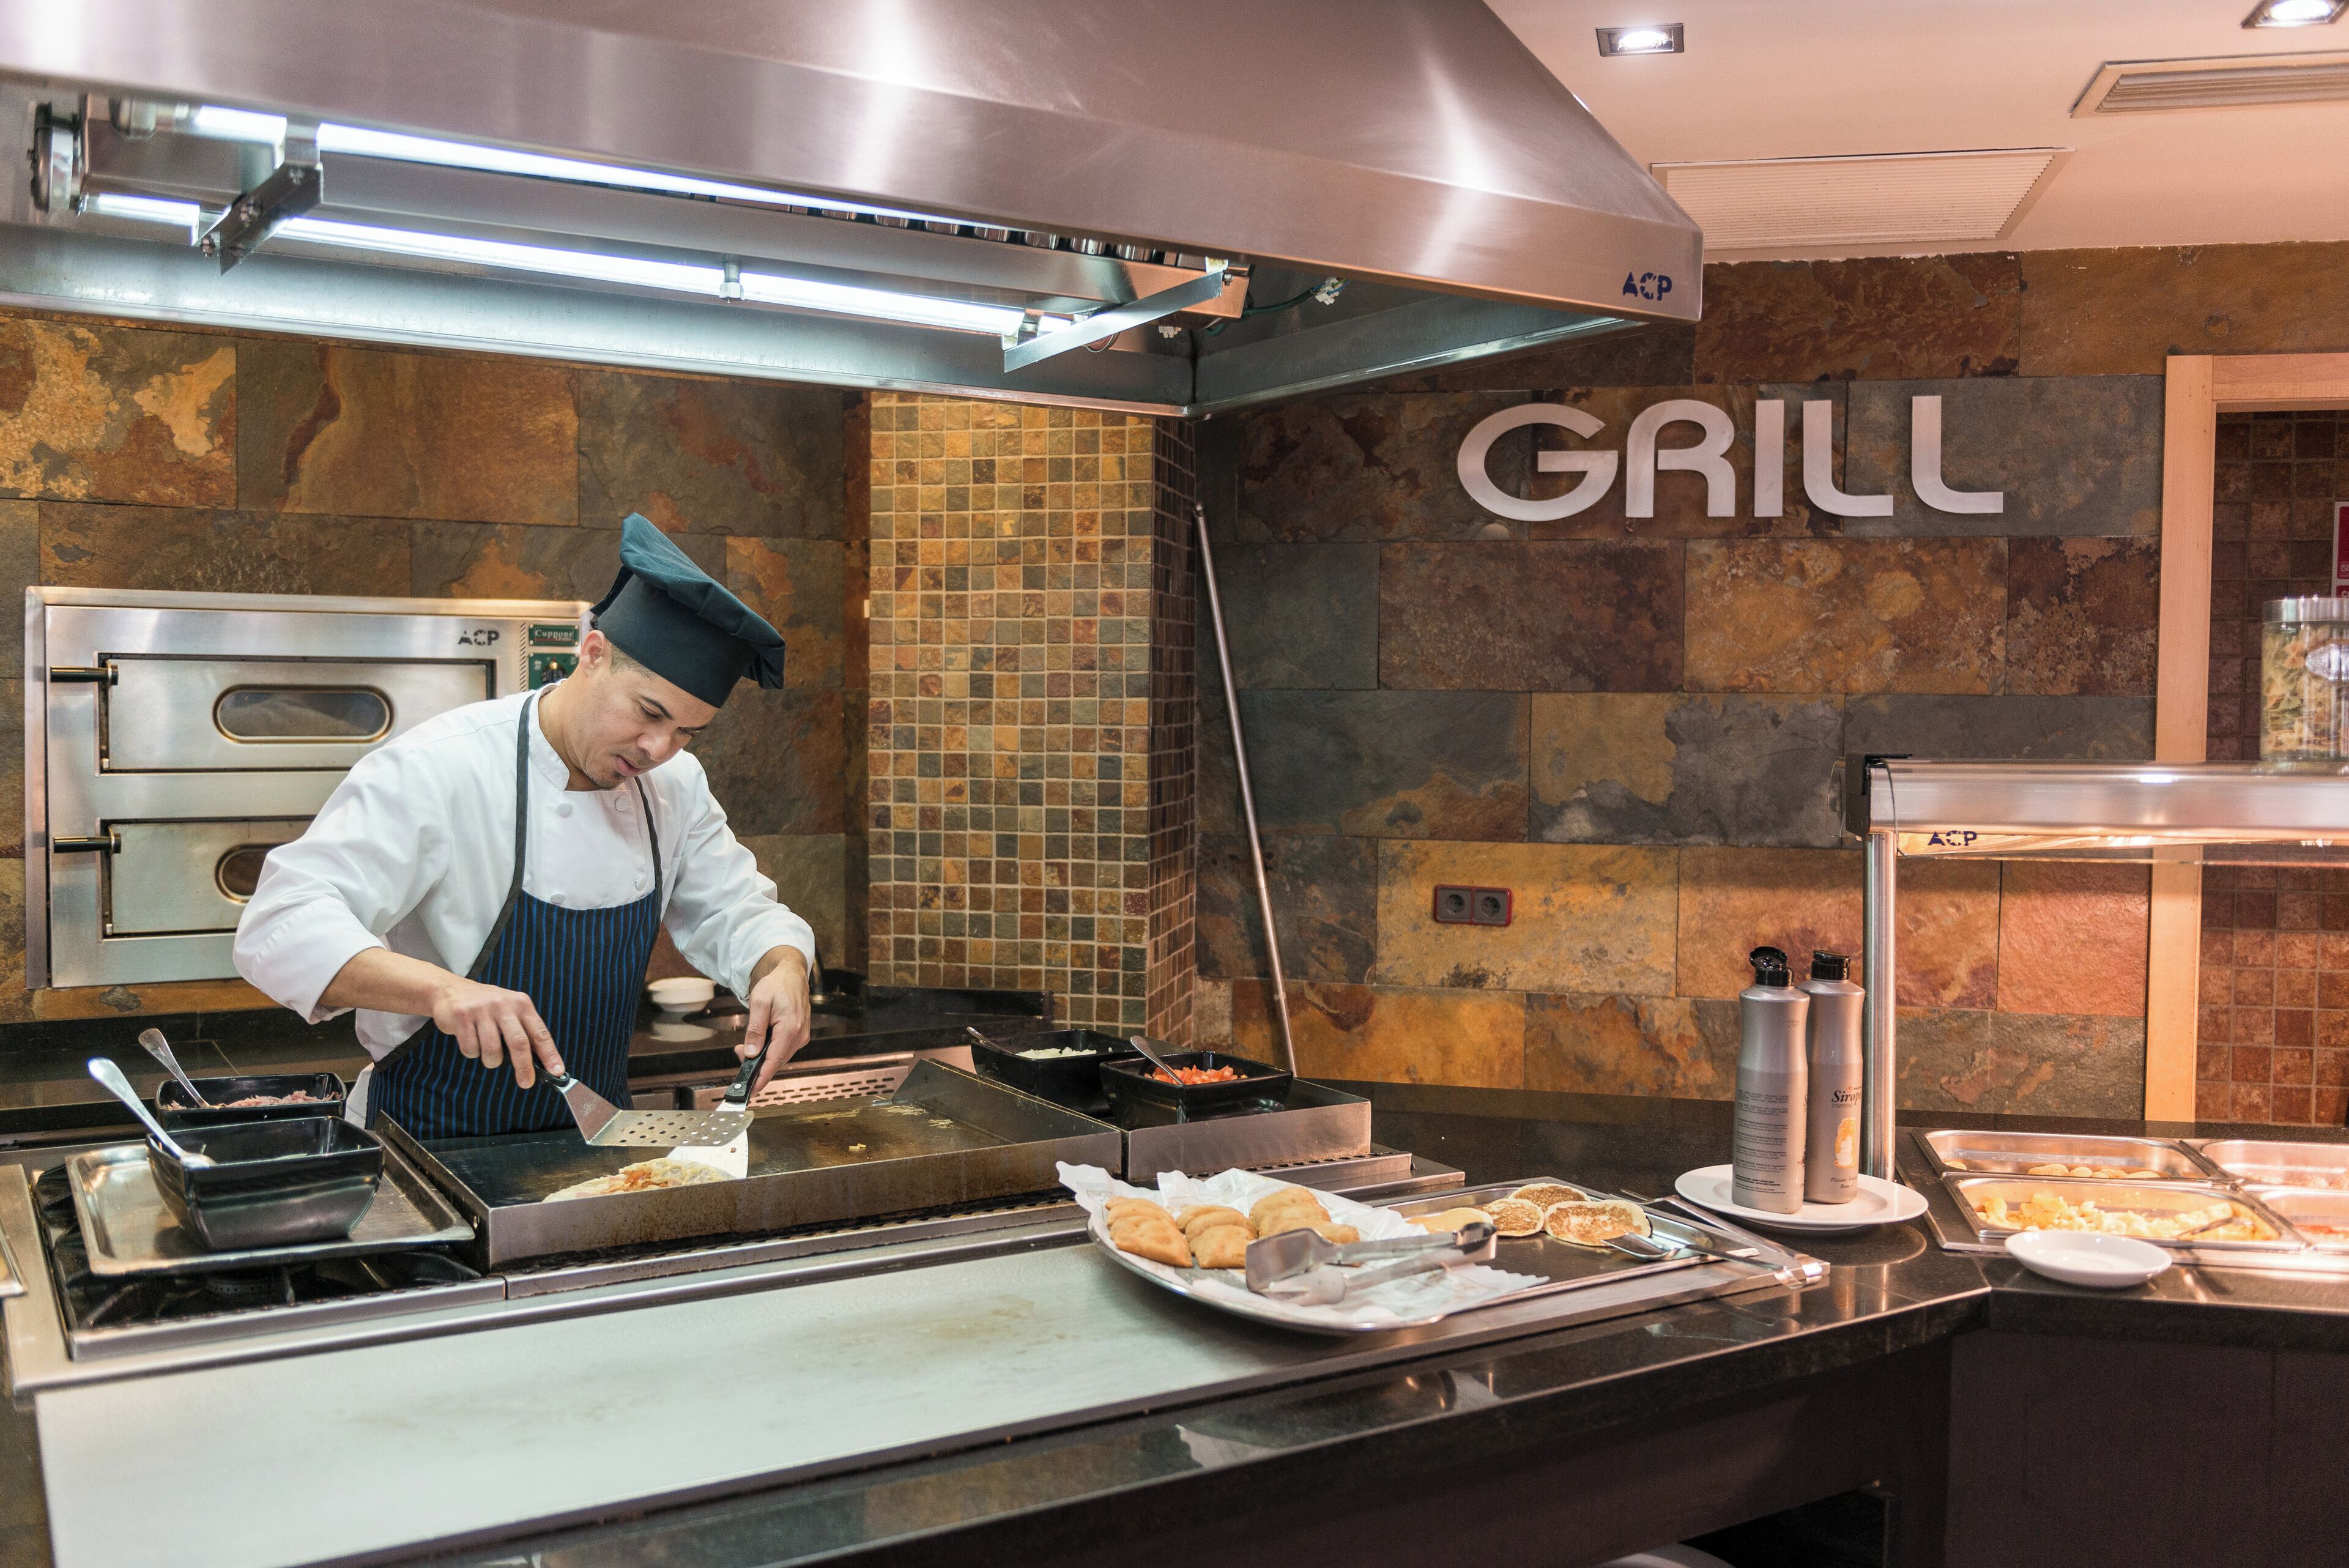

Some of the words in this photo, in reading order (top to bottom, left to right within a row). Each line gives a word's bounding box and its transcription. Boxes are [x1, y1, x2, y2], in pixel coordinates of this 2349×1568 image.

[1622, 272, 1672, 301] ACP
[1457, 395, 2003, 522] GRILL
[458, 629, 500, 646] ACP
[1928, 830, 1978, 846] ACP
